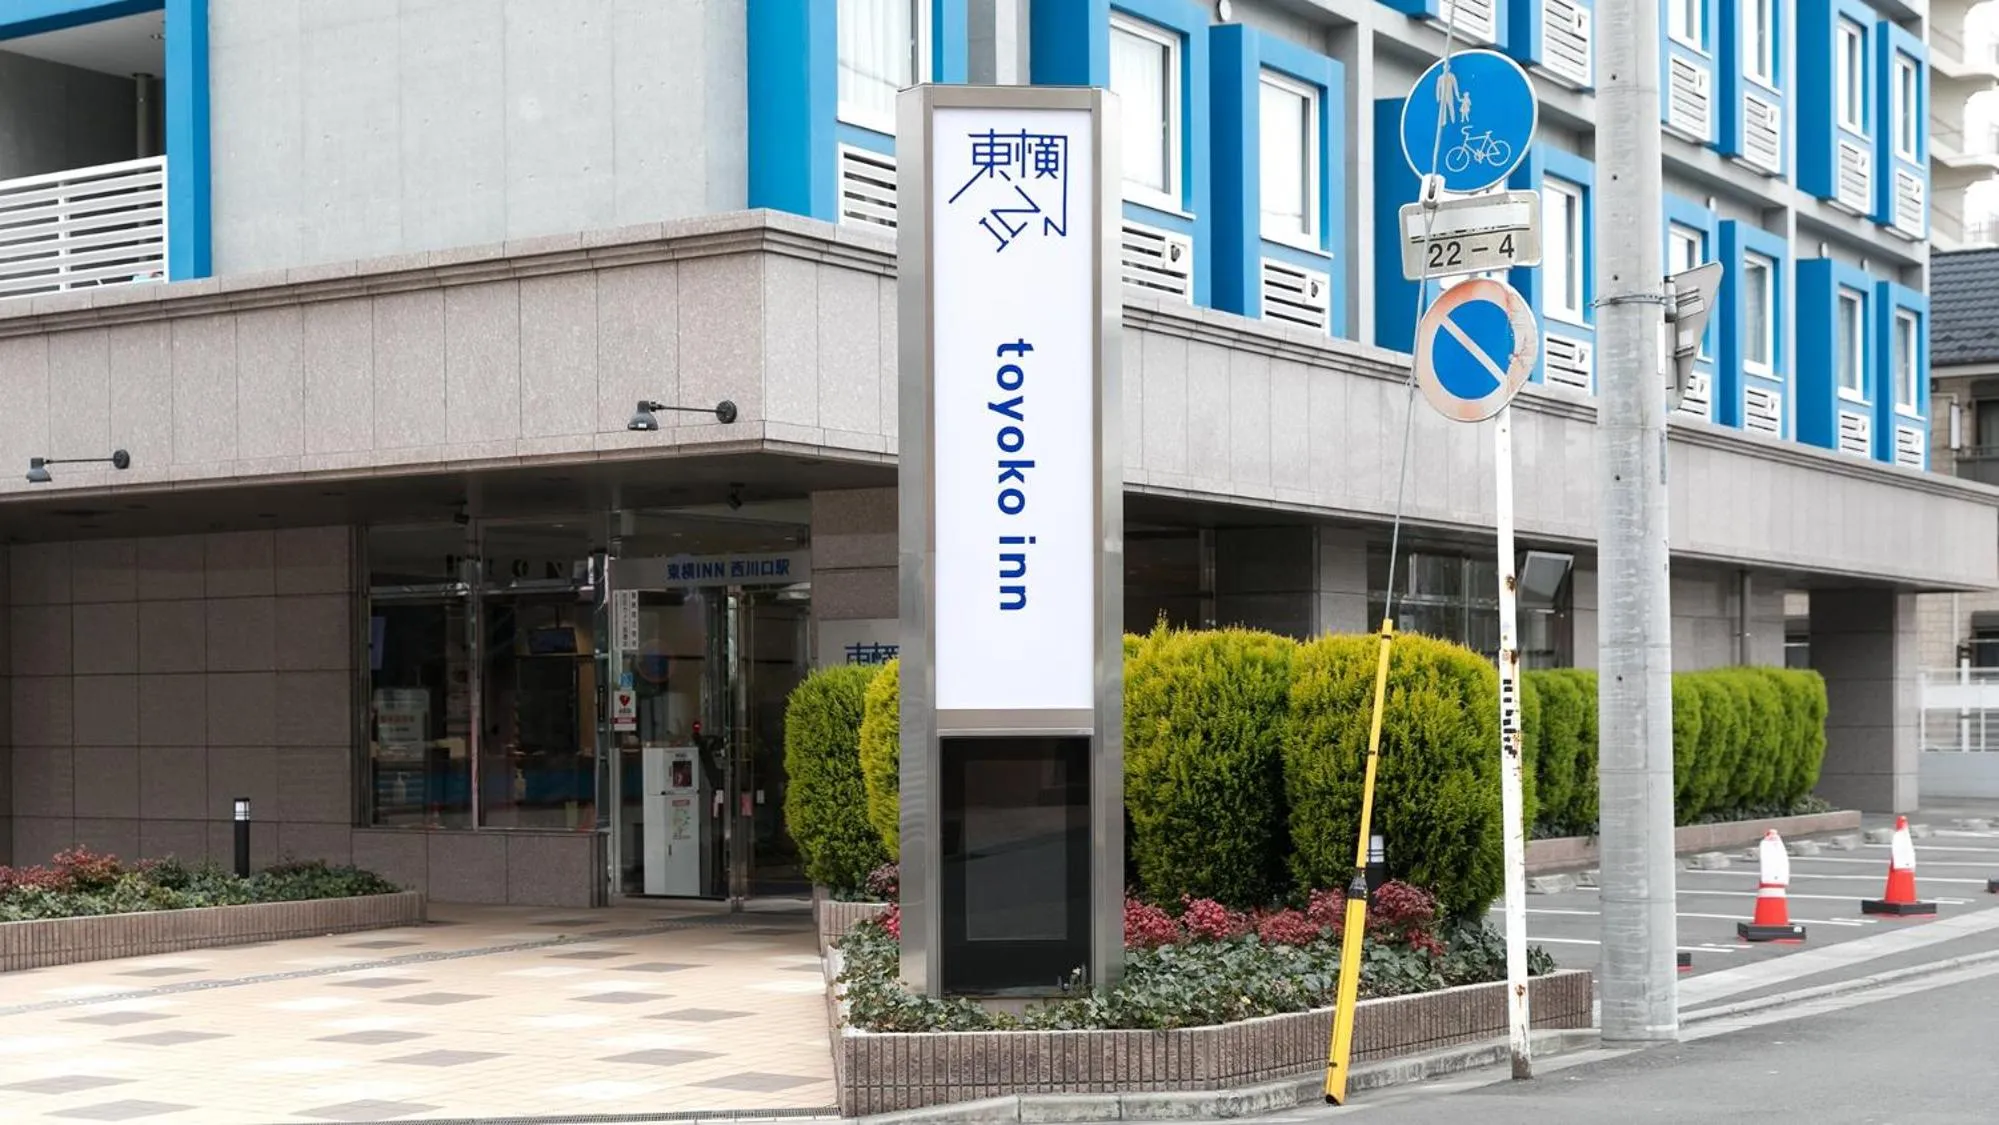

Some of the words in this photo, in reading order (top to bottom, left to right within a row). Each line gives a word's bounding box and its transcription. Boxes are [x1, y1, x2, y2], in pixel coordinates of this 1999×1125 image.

[988, 338, 1035, 515] toyoko
[667, 562, 725, 580] 東横INN
[731, 559, 790, 578] 西川口駅
[998, 536, 1037, 611] inn
